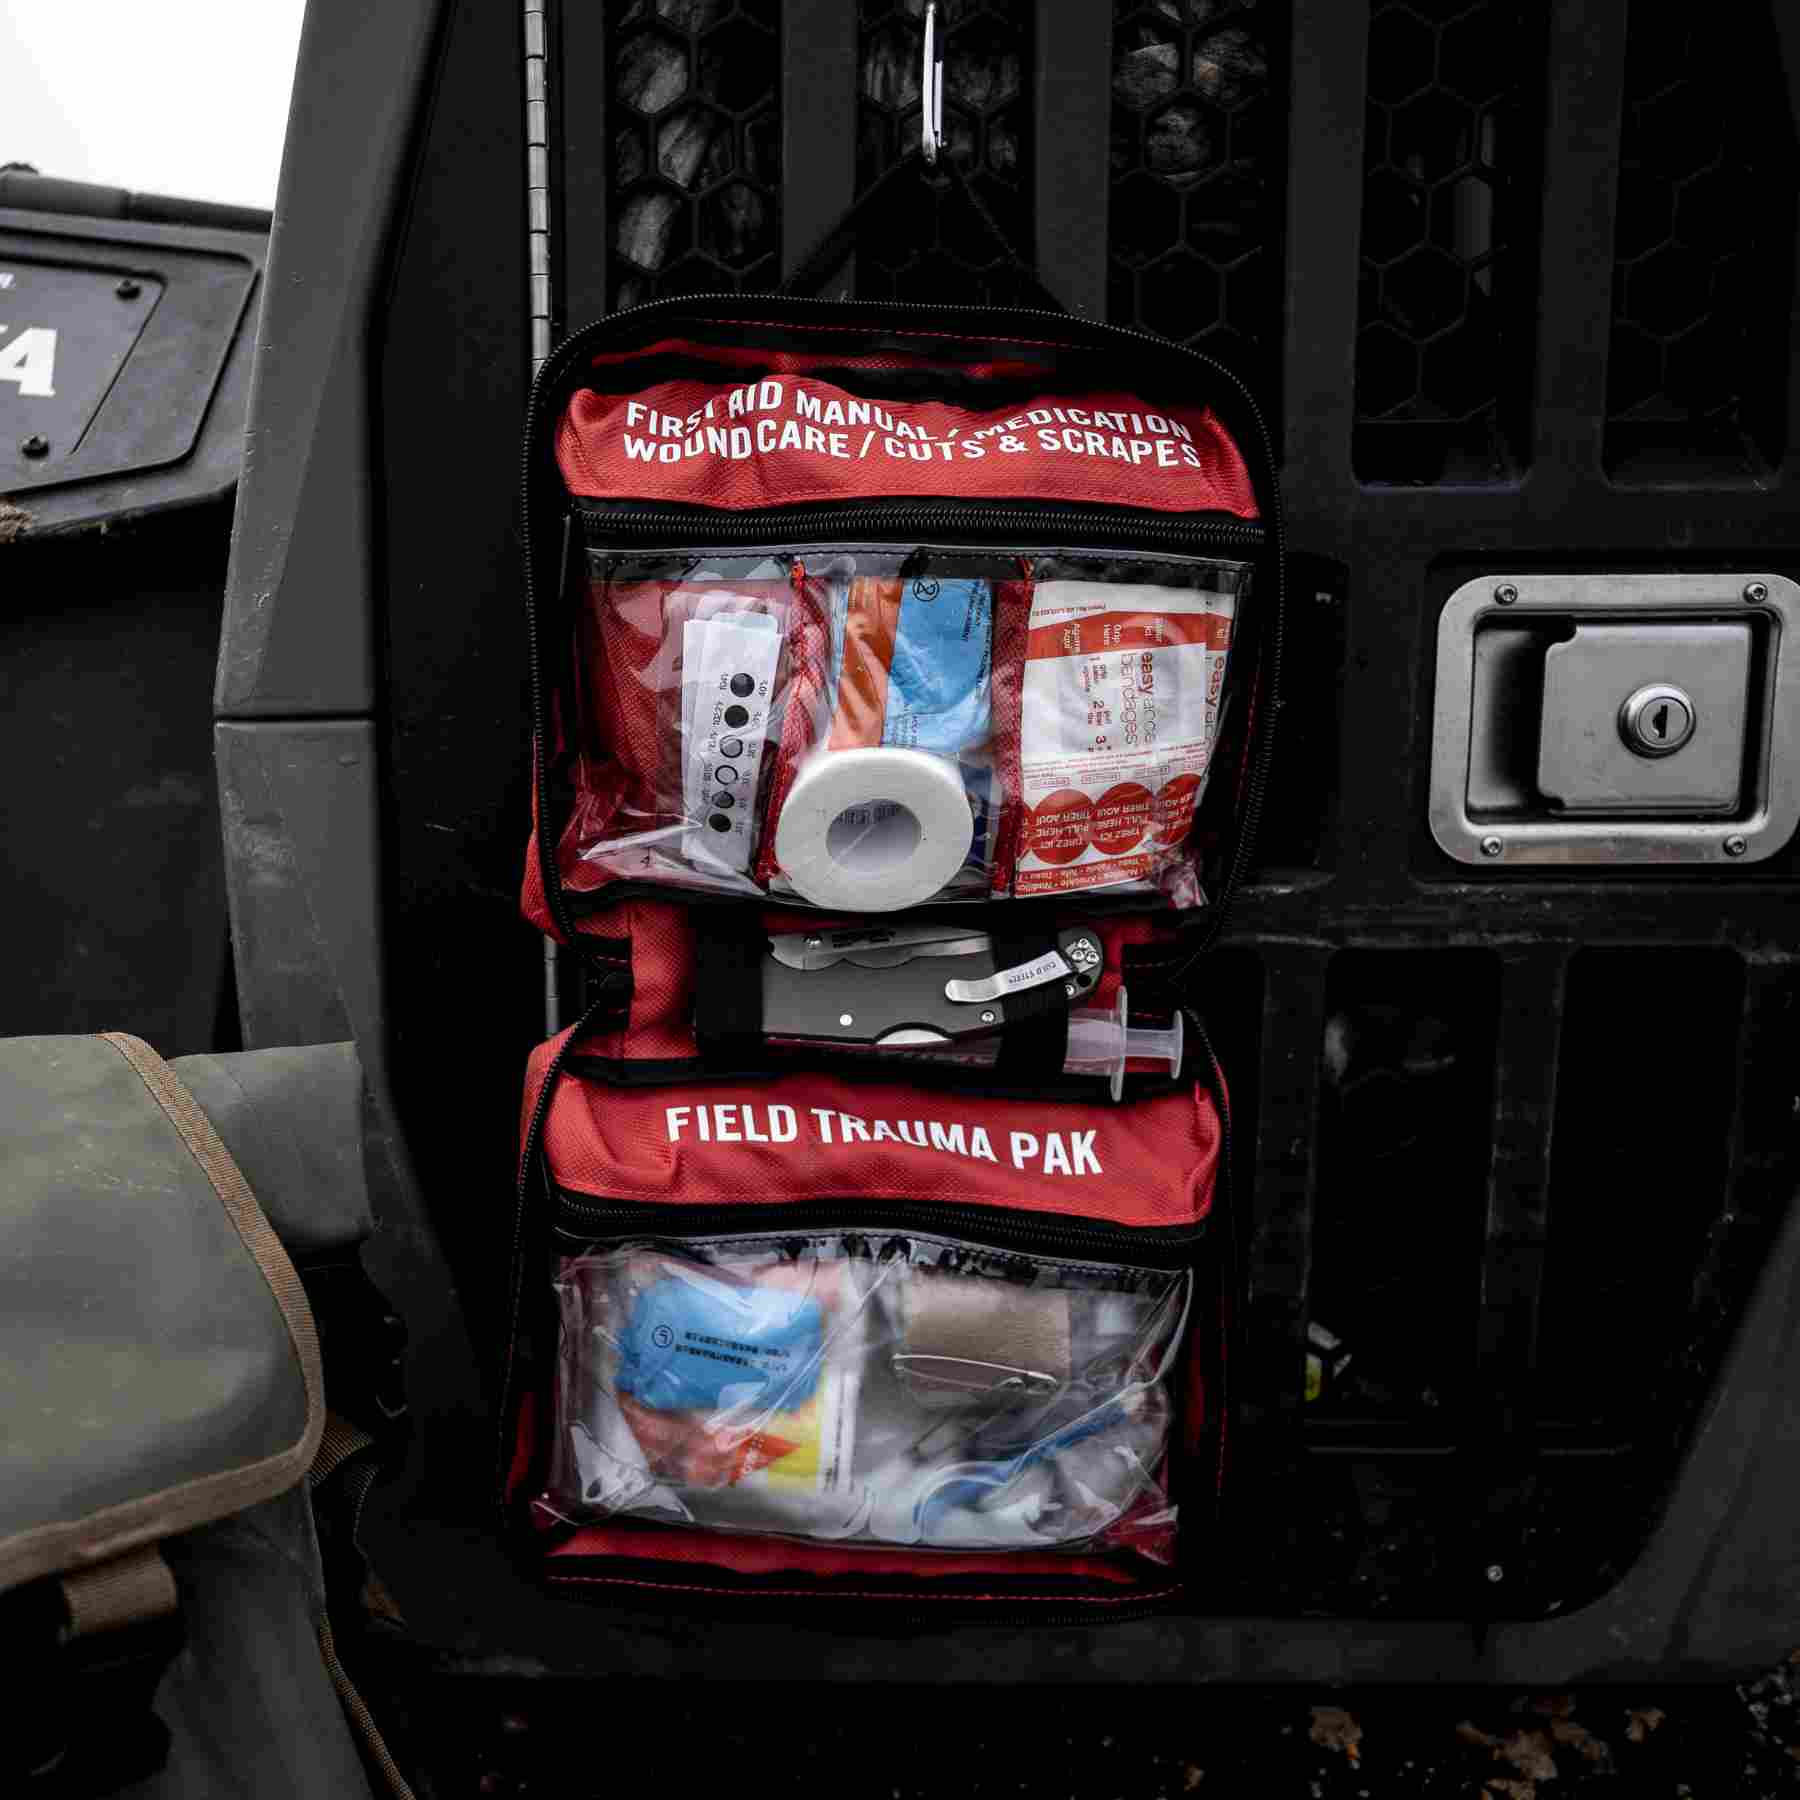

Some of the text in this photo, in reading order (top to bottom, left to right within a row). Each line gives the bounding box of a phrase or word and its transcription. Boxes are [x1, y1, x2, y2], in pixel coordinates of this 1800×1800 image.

[627, 399, 714, 438] FIRST
[728, 380, 784, 419] AID
[795, 388, 939, 442] MANUAL
[972, 406, 1193, 442] MEDICATION
[884, 434, 986, 462] CUTS
[1000, 435, 1029, 453] &
[1037, 427, 1202, 469] SCRAPES
[665, 1103, 1104, 1176] FIELD TRAUMA PAK
